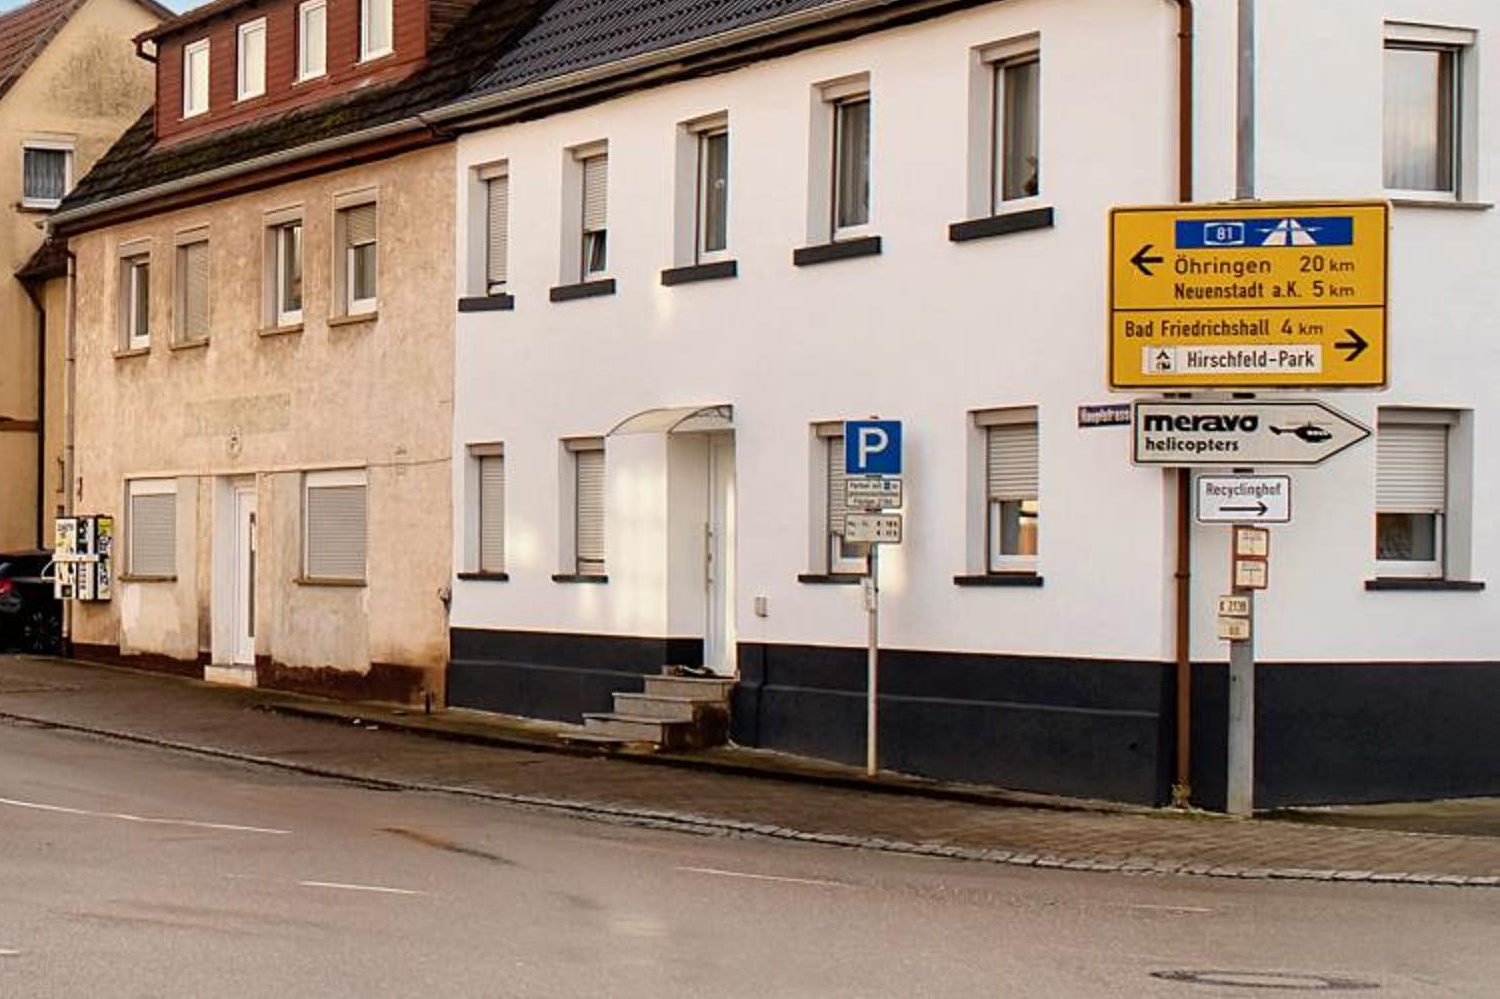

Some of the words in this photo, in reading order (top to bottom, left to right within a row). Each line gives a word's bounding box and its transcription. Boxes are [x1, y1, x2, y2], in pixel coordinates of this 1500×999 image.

[1216, 227, 1234, 240] 81
[1174, 254, 1271, 277] Öhringen
[1300, 256, 1323, 273] 20
[1329, 258, 1355, 272] km
[1174, 282, 1264, 300] Neuenstadt
[1272, 281, 1302, 299] a.K.
[1313, 281, 1325, 297] 5
[1329, 283, 1355, 296] km
[1125, 320, 1153, 338] Bad
[1161, 319, 1269, 337] Friedrichshall
[1281, 319, 1294, 335] 4
[1299, 321, 1323, 335] km
[1187, 350, 1315, 369] Hirschfeld-Park
[1143, 414, 1259, 432] meravo
[858, 426, 889, 469] P
[1145, 436, 1239, 454] helicopters
[1205, 482, 1282, 499] Recyclinghof
